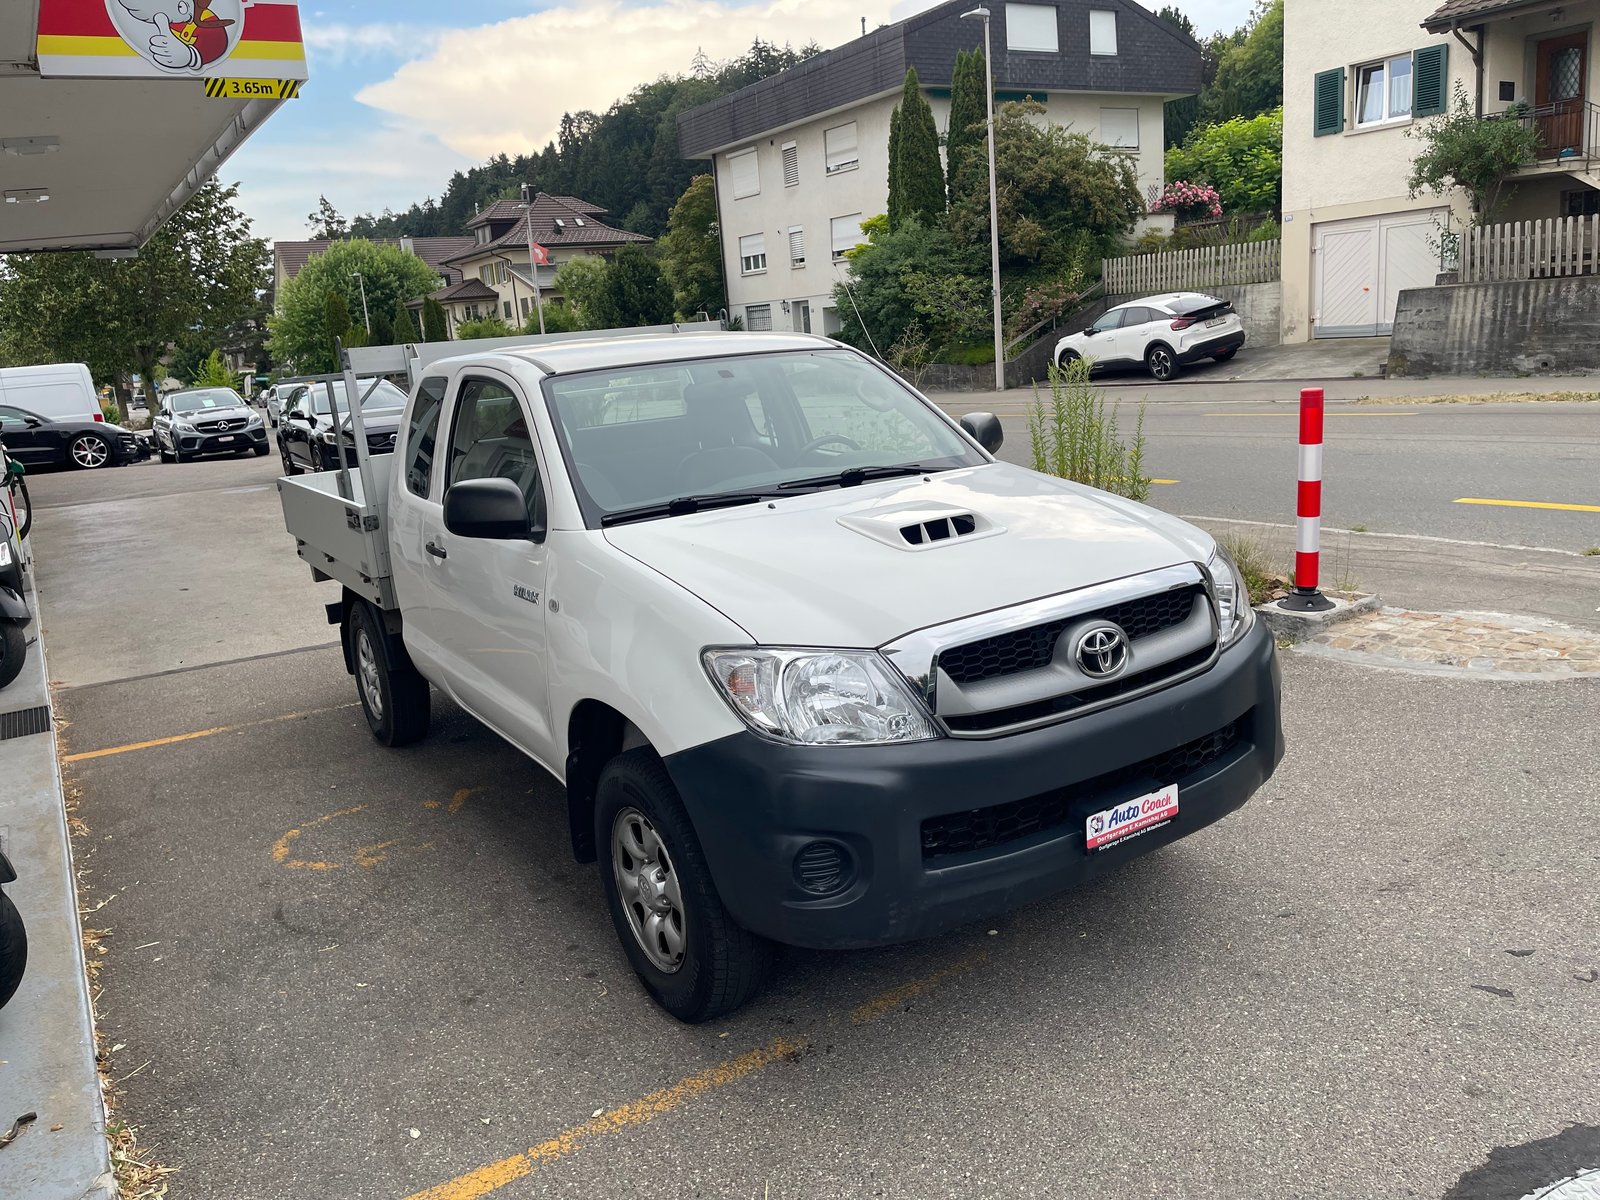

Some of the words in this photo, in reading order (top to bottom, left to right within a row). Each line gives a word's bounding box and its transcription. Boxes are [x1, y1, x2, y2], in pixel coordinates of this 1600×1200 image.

[232, 82, 273, 94] 3.65m
[1097, 827, 1128, 843] Dorfgarage
[1160, 810, 1168, 818] AG
[1109, 805, 1139, 828] Auto
[1142, 794, 1172, 814] Coach
